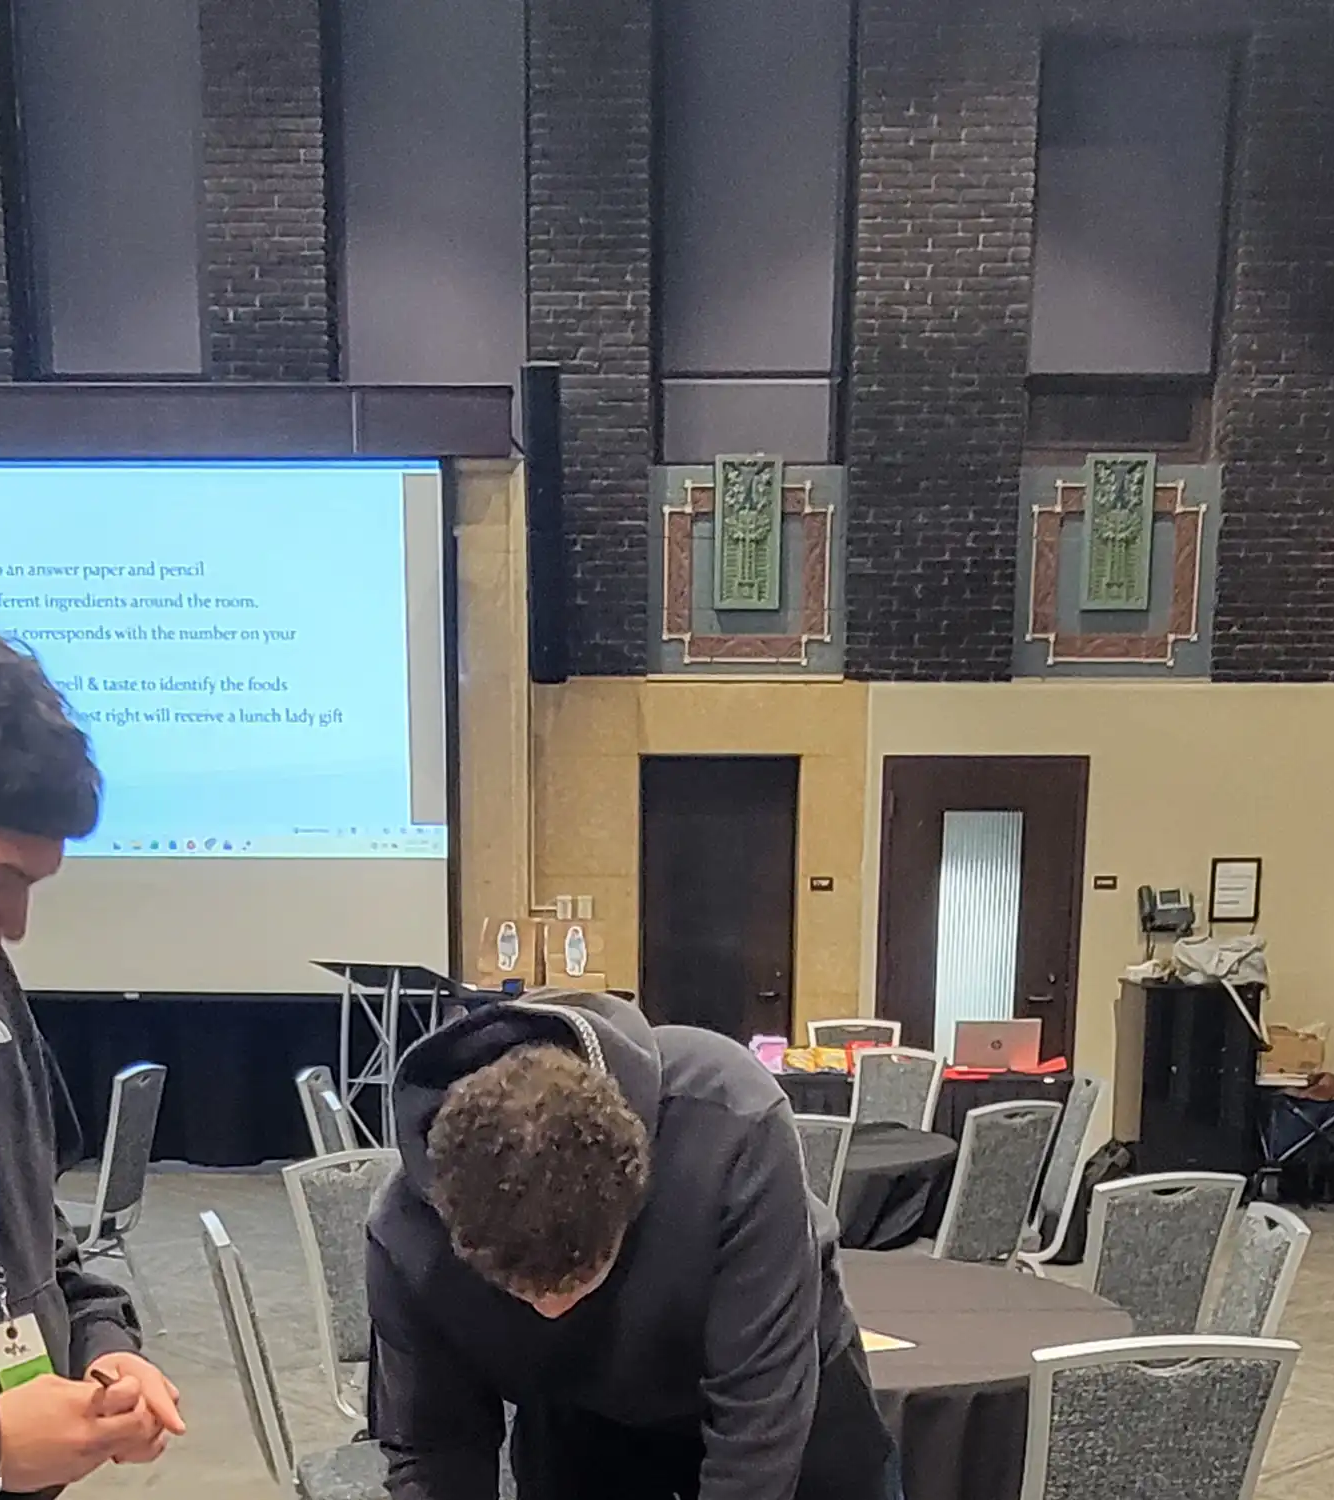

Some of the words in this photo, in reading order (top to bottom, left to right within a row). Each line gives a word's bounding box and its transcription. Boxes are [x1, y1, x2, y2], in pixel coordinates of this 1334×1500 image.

[6, 566, 24, 577] an
[27, 566, 79, 577] answer
[82, 565, 125, 581] paper
[127, 560, 156, 577] and
[160, 560, 205, 581] pencil
[44, 592, 127, 612] ingredients
[130, 592, 183, 609] around
[187, 592, 211, 609] the
[215, 597, 259, 609] room.
[22, 625, 112, 644] corresponds
[115, 625, 148, 641] with
[151, 625, 175, 641] the
[179, 625, 237, 641] number
[240, 631, 259, 641] on
[262, 630, 297, 644] your
[87, 676, 99, 691] &
[103, 678, 137, 692] taste
[141, 678, 156, 692] to
[160, 675, 215, 695] identify
[220, 676, 244, 692] the
[248, 676, 288, 692] foods
[105, 708, 140, 726] right
[143, 708, 170, 722] will
[175, 709, 224, 723] receive
[227, 713, 236, 723] a
[239, 708, 281, 723] lunch
[285, 708, 315, 726] lady
[319, 708, 343, 727] gift
